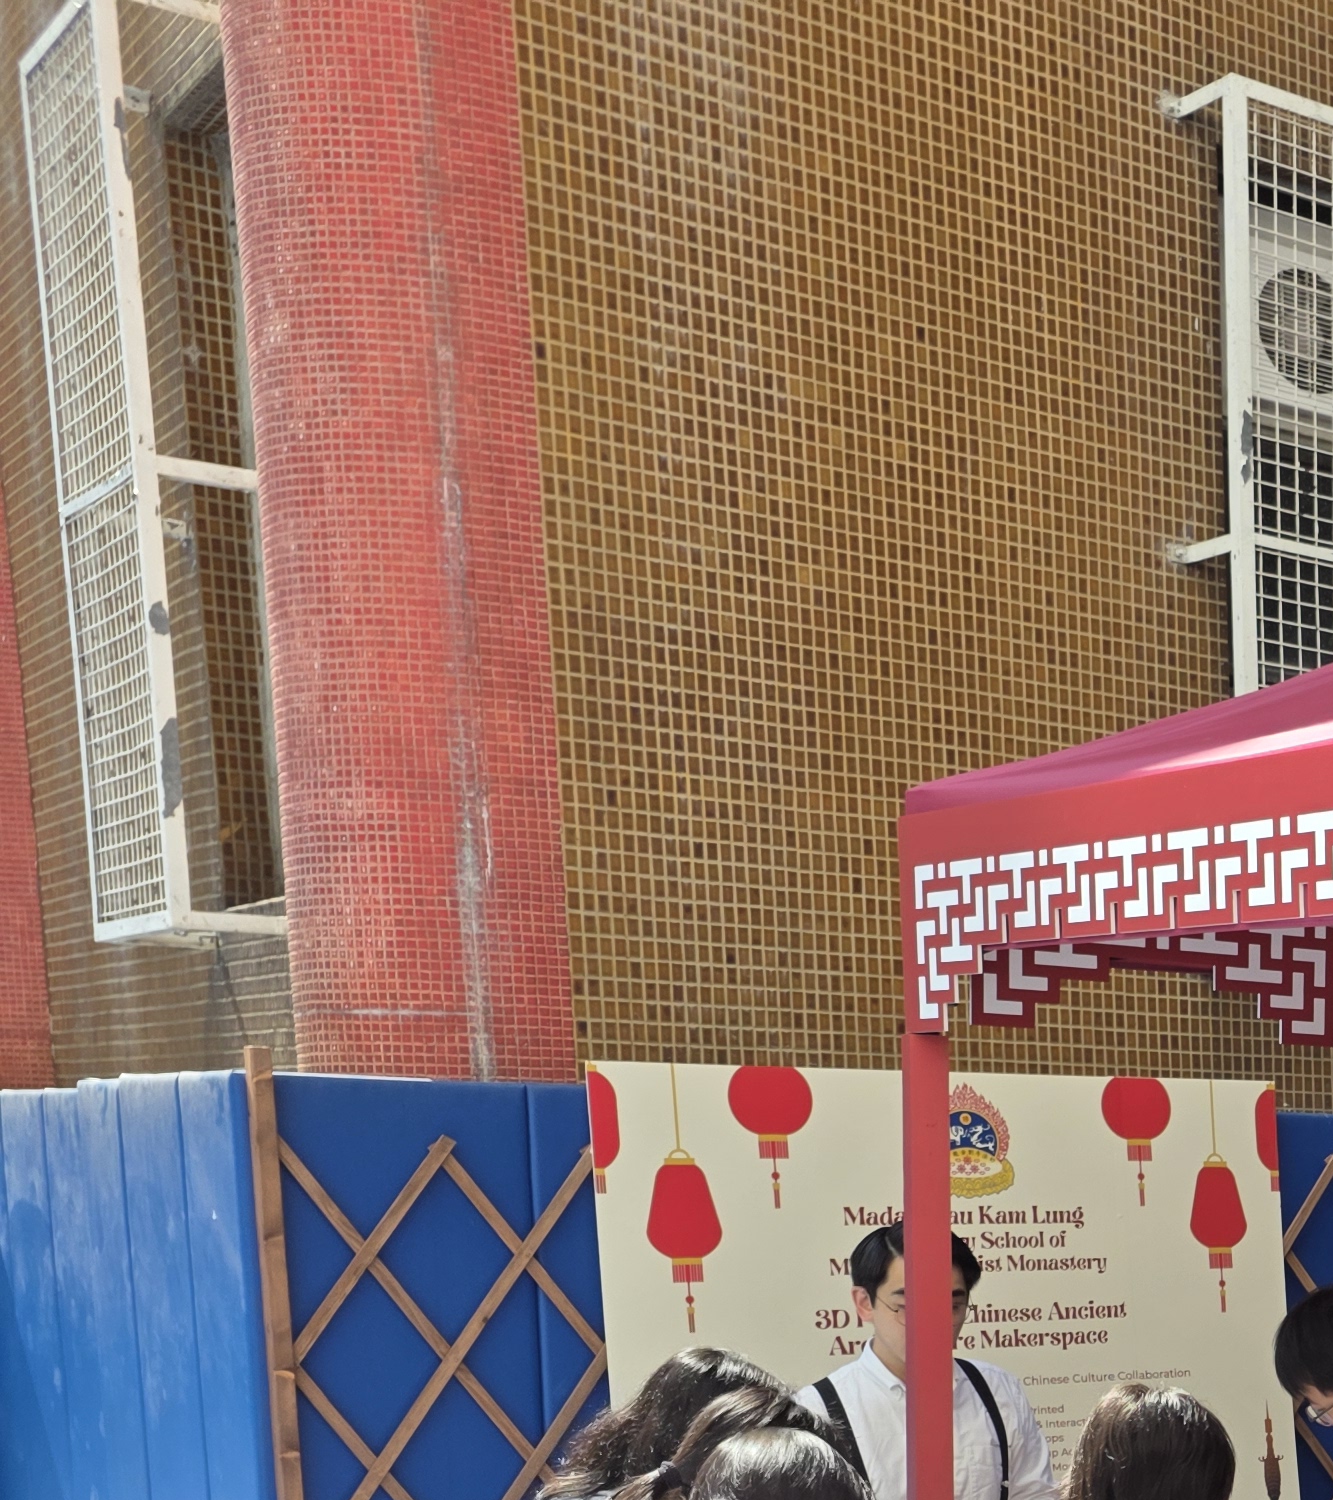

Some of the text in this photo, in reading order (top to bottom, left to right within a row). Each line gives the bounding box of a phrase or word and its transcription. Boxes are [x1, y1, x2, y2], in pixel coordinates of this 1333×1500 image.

[843, 1205, 1085, 1229] Mada au Kam Lung
[980, 1231, 1044, 1250] School
[1049, 1231, 1066, 1249] of
[1007, 1256, 1108, 1274] Monastery
[815, 1309, 851, 1330] 3D
[1048, 1301, 1128, 1322] Ancient
[981, 1329, 1109, 1355] Makerspace
[1023, 1368, 1191, 1387] Chinese Culture Collaboration
[1045, 1418, 1087, 1428] Interact
